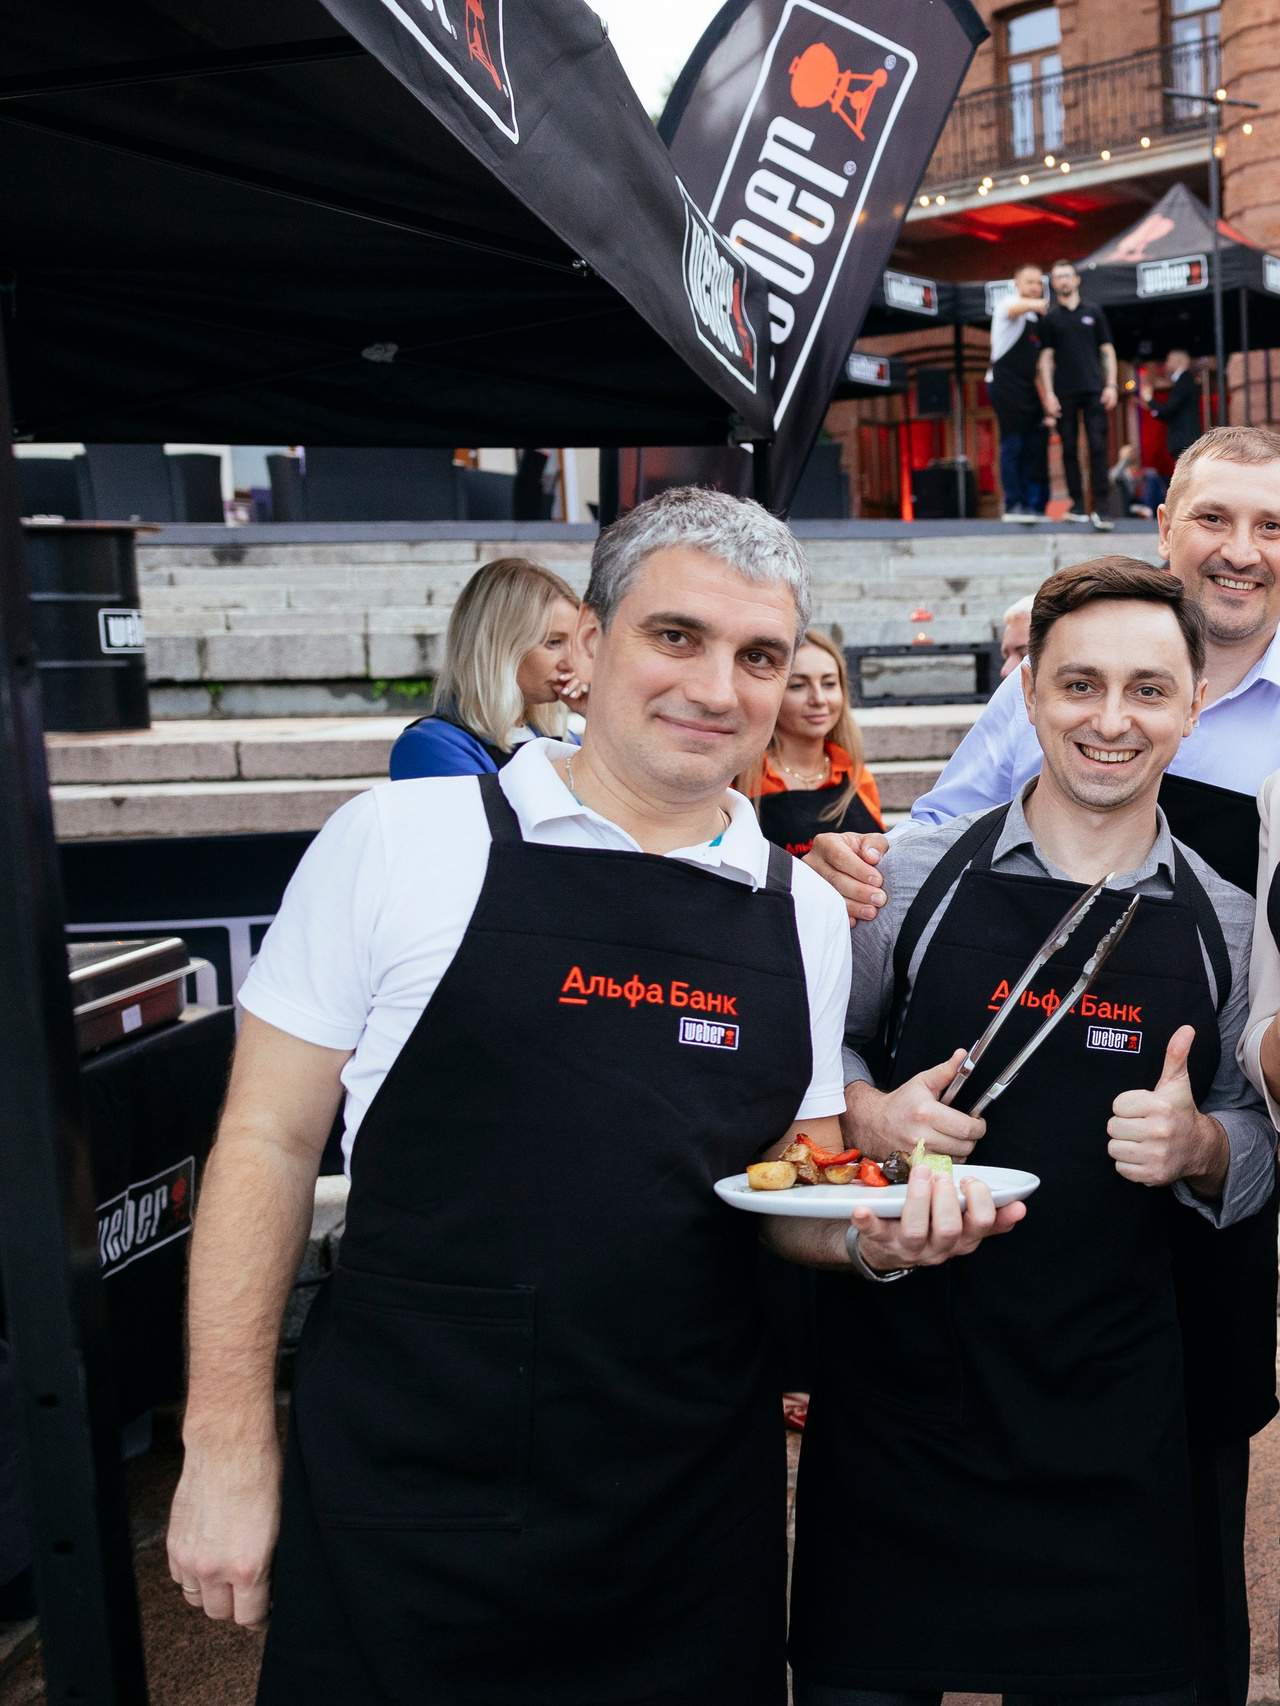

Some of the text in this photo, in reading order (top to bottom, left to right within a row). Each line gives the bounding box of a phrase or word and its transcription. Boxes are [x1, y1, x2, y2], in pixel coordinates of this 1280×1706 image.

[723, 115, 849, 381] ber
[559, 966, 739, 1017] Альфа Банк
[988, 979, 1142, 1023] Аьф Банк
[684, 1020, 726, 1045] weber
[1091, 1028, 1128, 1049] weber
